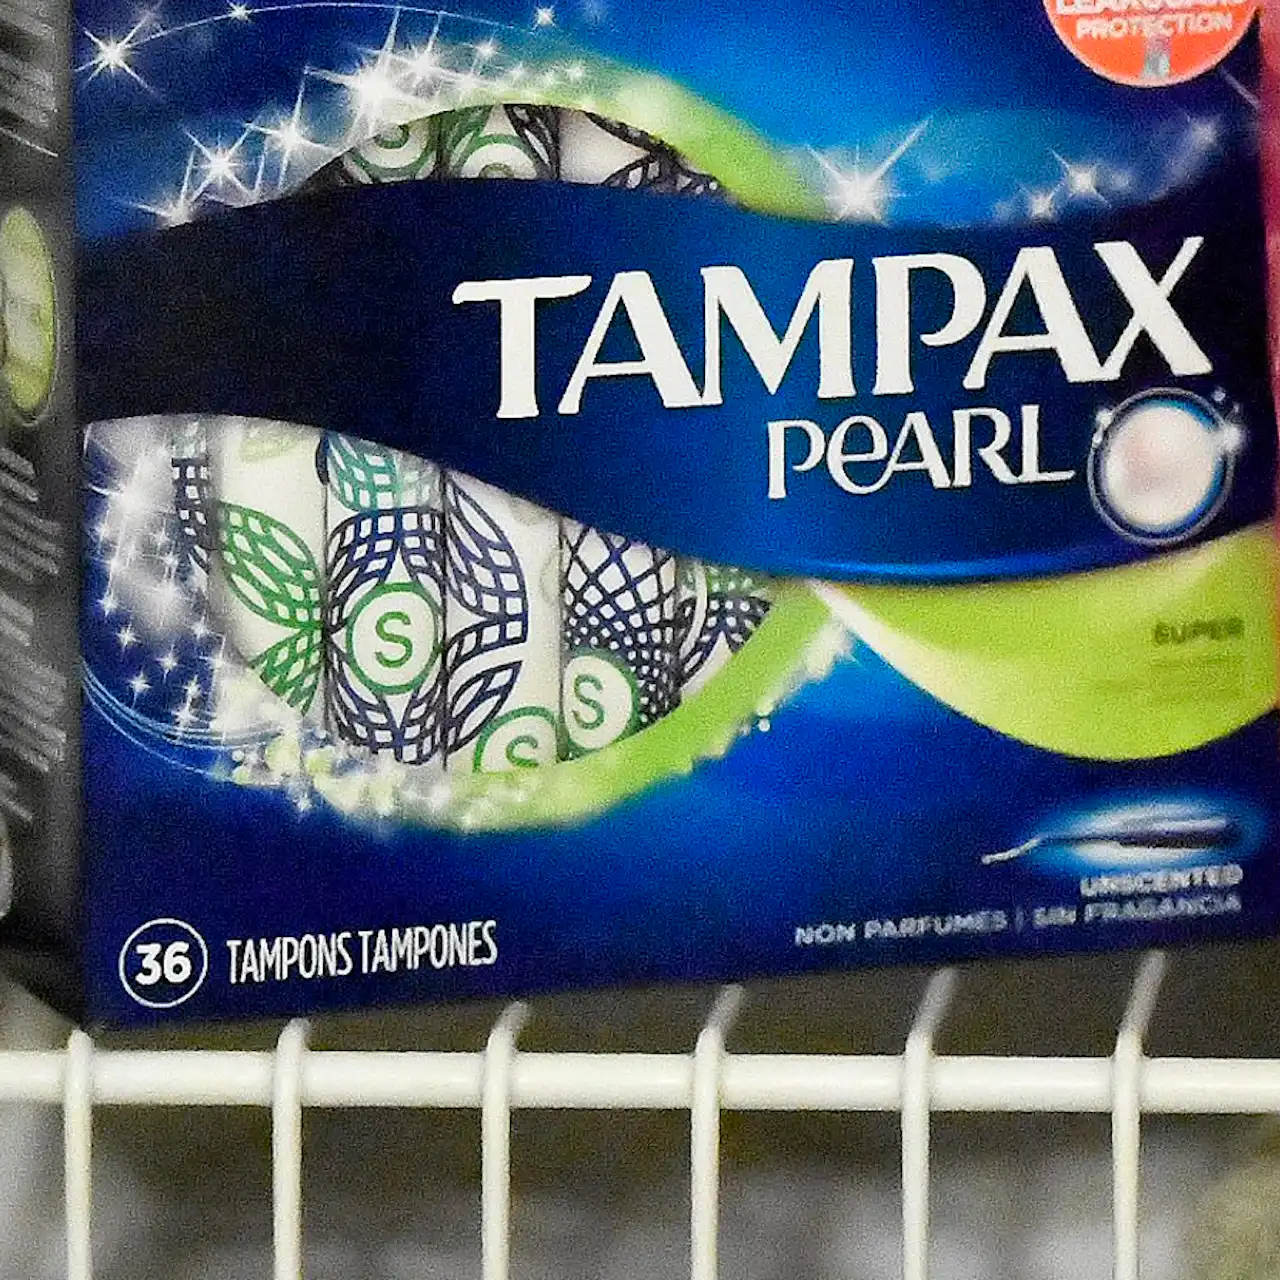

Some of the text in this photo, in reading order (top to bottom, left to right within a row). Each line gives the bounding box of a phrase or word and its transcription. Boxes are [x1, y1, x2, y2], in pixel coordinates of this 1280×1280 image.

[1076, 12, 1233, 39] PROTECTION
[451, 236, 1214, 420] TAMPAX
[373, 610, 414, 669] S
[572, 673, 605, 730] S
[135, 919, 498, 986] 36 TAMPONS TAMPONES
[794, 922, 856, 947] NON
